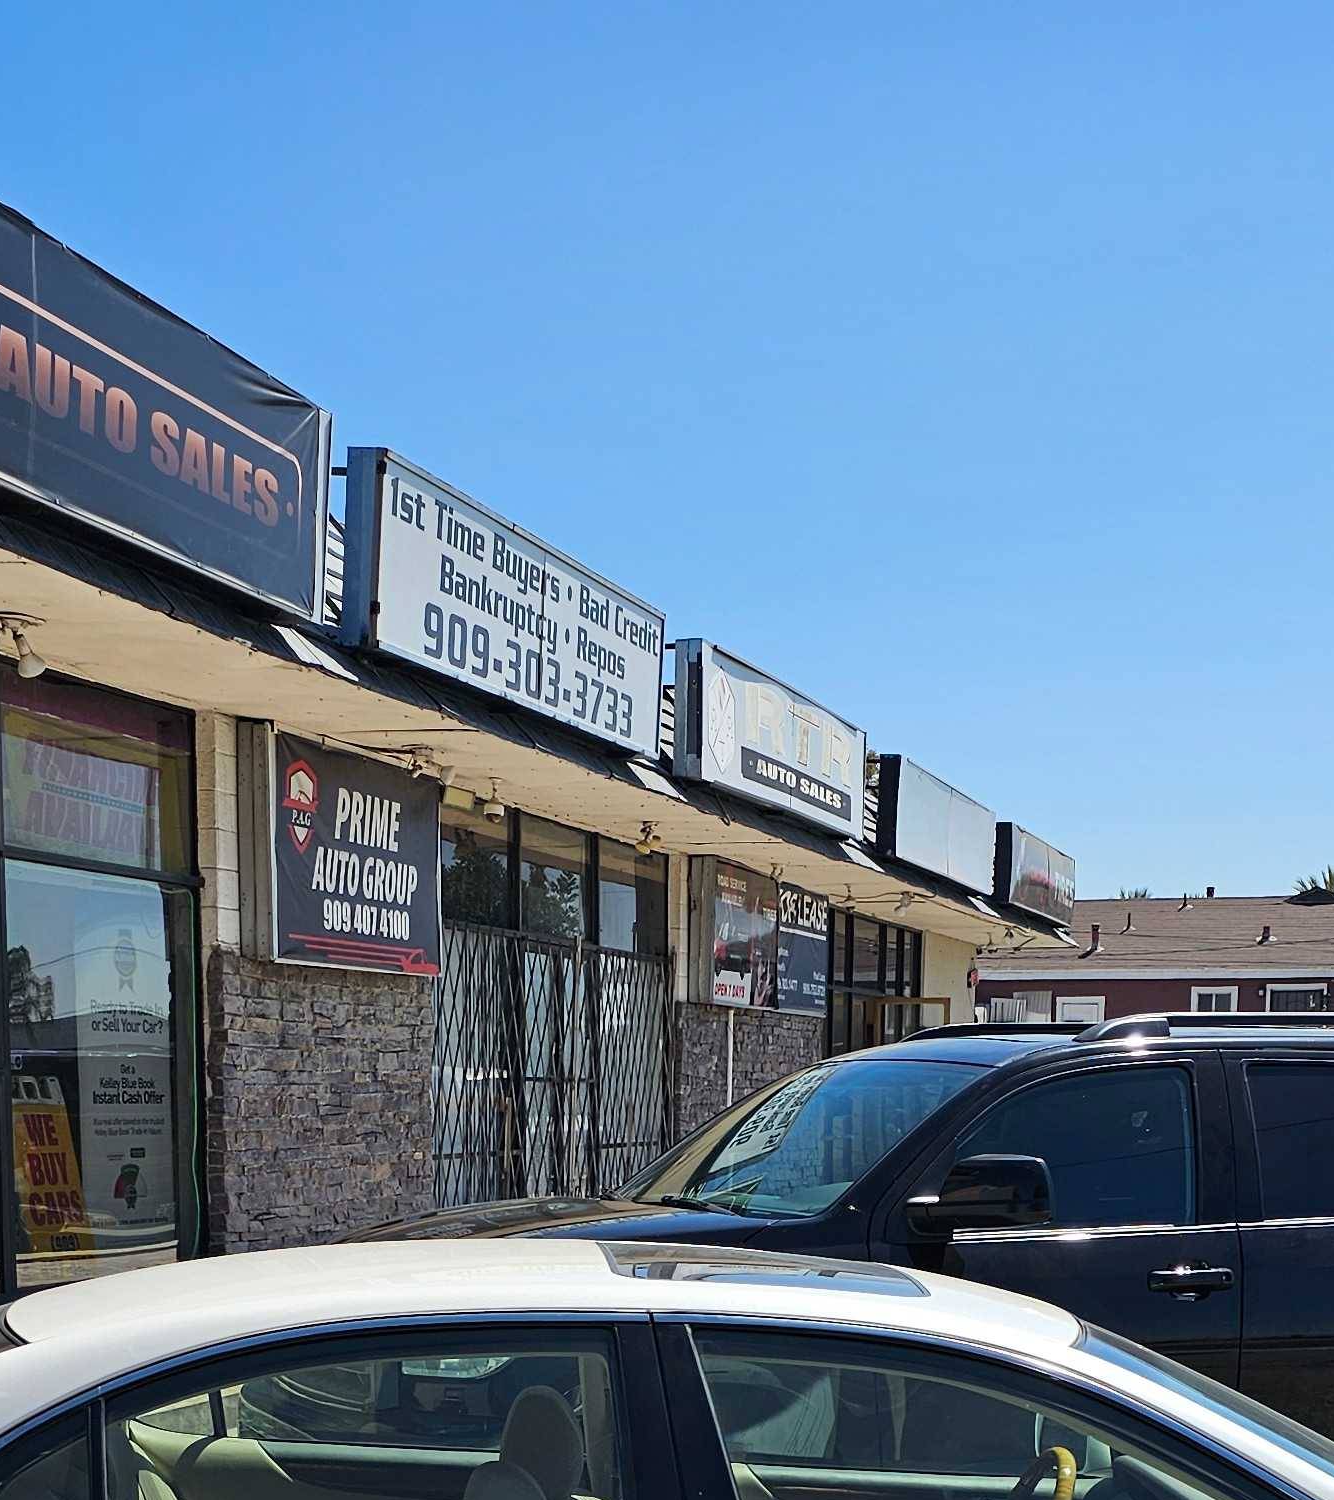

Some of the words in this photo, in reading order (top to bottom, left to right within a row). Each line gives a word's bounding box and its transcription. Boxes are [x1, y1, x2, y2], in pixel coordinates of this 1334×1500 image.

[151, 411, 279, 527] SALES
[390, 477, 426, 532] 1st
[434, 499, 485, 562] Time
[491, 532, 560, 604] Buyers
[578, 583, 610, 633] Bad
[614, 606, 659, 657] Credit
[439, 553, 558, 657] Bankruptcy
[576, 625, 626, 680] Repos
[423, 601, 634, 739] 909-303-3733
[755, 758, 797, 789] AUTO
[799, 779, 842, 809] SALES
[334, 787, 401, 852] PRIME
[311, 846, 360, 897] AUTO
[363, 856, 418, 906] GROUP
[323, 898, 351, 936] 909
[354, 904, 378, 936] 407
[380, 908, 410, 941] 4100
[797, 893, 827, 932] LEASE
[92, 1020, 101, 1031] or
[102, 1018, 120, 1033] Sell
[121, 1018, 141, 1033] Your
[142, 1019, 164, 1034] Car?
[92, 1090, 120, 1105] Instant
[122, 1090, 143, 1105] Cash
[144, 1090, 165, 1105] Offer
[121, 1077, 137, 1089] Blue
[137, 1077, 155, 1089] Book
[23, 1114, 59, 1146] WE
[27, 1153, 69, 1186] BUY
[29, 1190, 84, 1227] CARS
